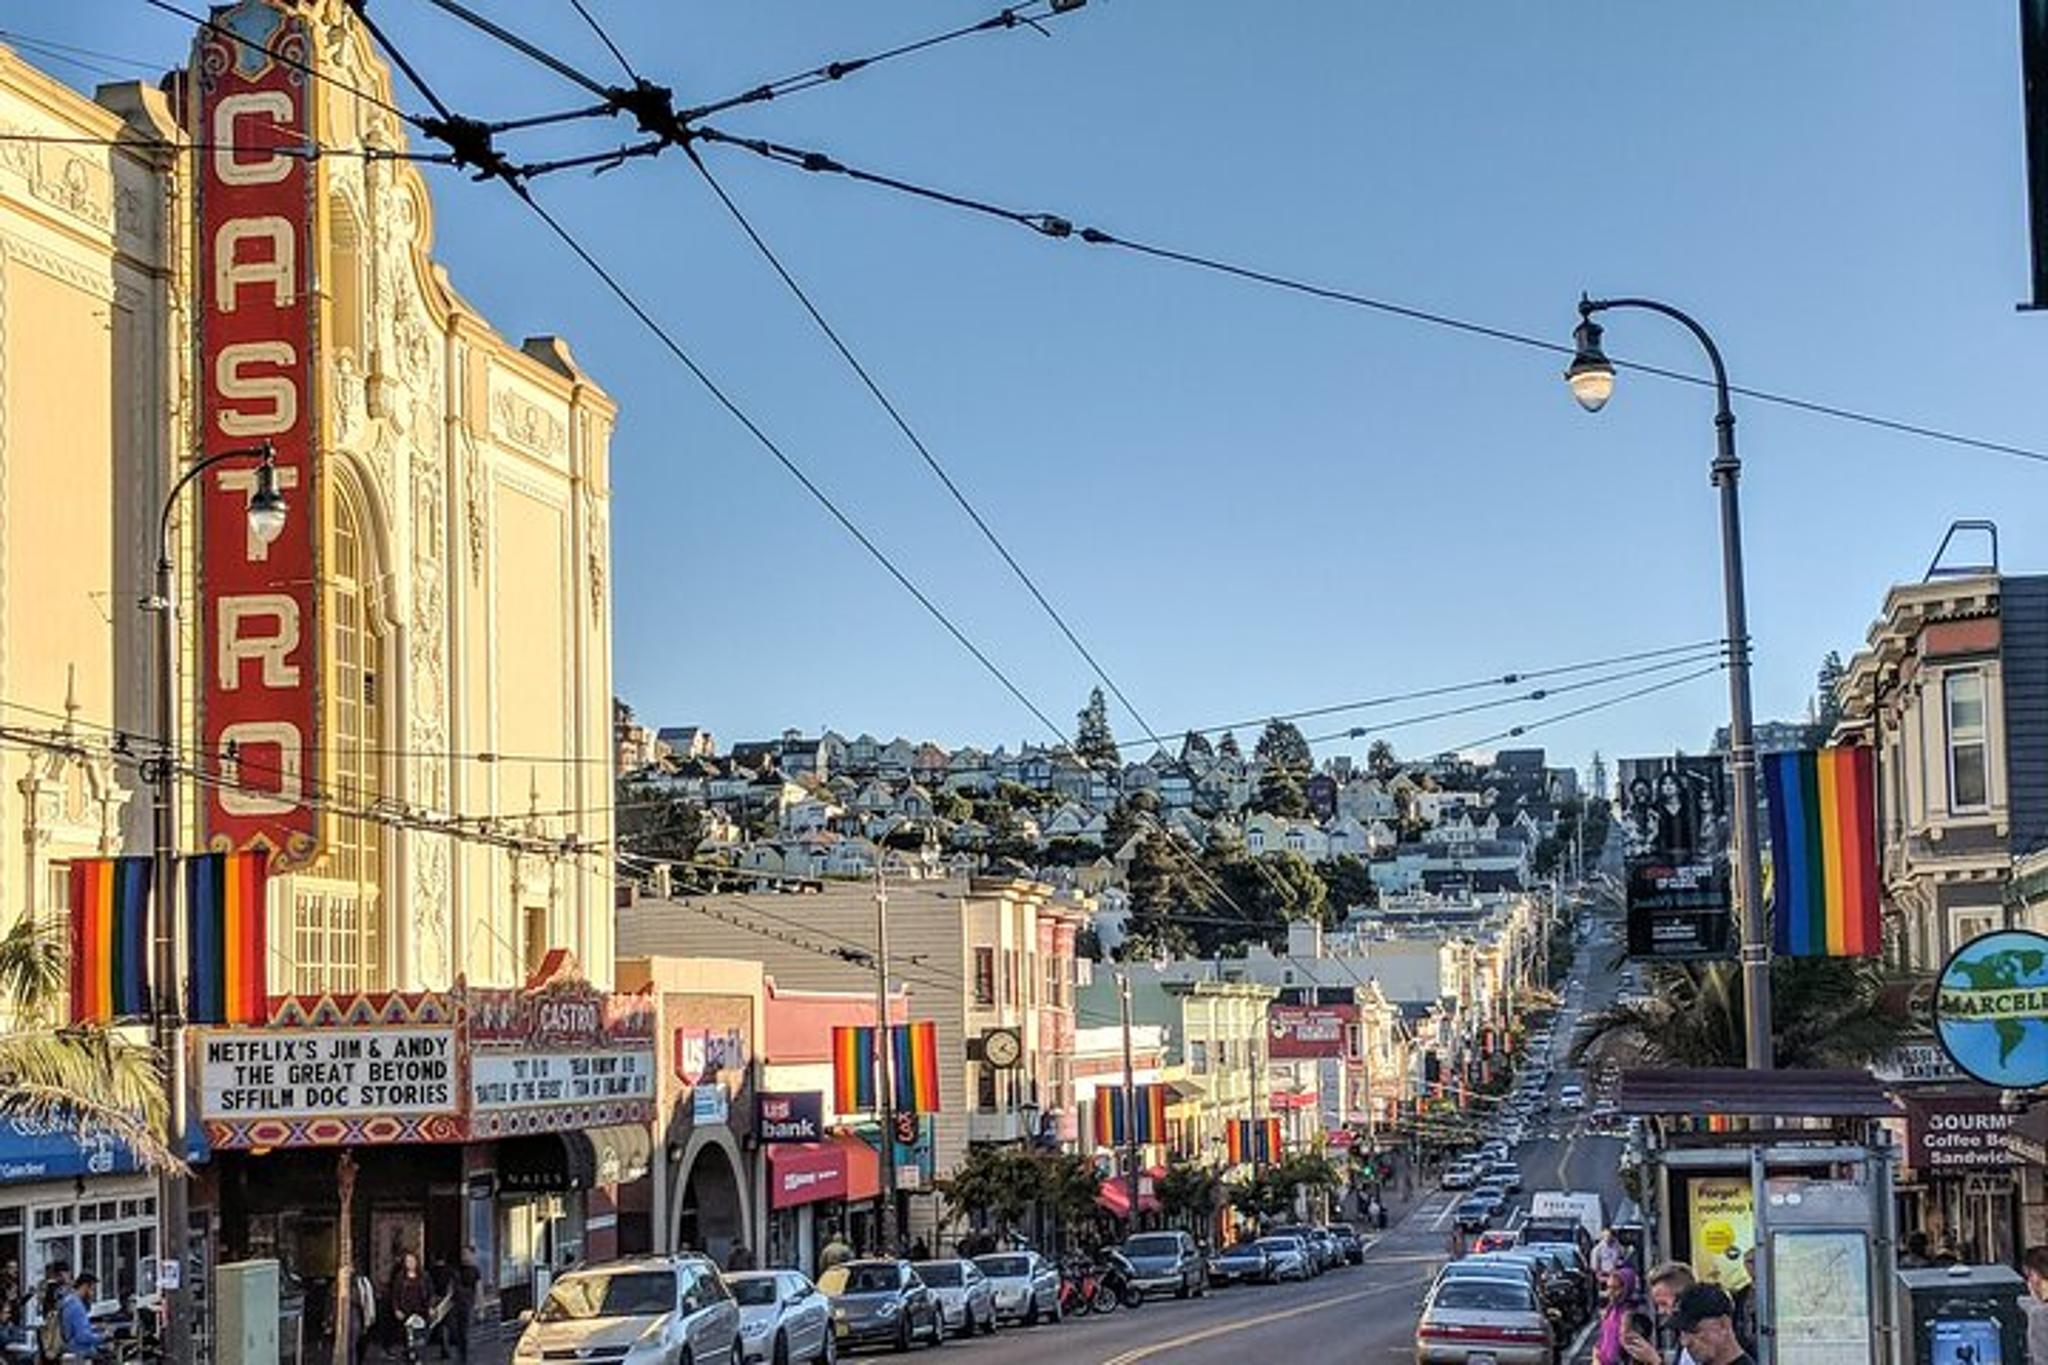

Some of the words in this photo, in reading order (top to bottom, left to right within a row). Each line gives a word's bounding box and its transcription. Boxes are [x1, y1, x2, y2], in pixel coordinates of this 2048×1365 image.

[212, 89, 302, 817] CASTRO
[540, 1003, 597, 1031] CASTRO
[208, 1040, 318, 1063] NETFLIX'S
[329, 1040, 361, 1060] JIM
[368, 1038, 382, 1059] &
[393, 1037, 448, 1058] ANDY
[234, 1065, 275, 1085] THE
[288, 1063, 356, 1084] GREAT
[369, 1060, 448, 1082] BEYOND
[221, 1088, 294, 1110] SFFILM
[306, 1086, 349, 1107] DOC
[361, 1084, 448, 1105] STORIES
[762, 1119, 815, 1138] bank
[1923, 1134, 1981, 1147] Coffee
